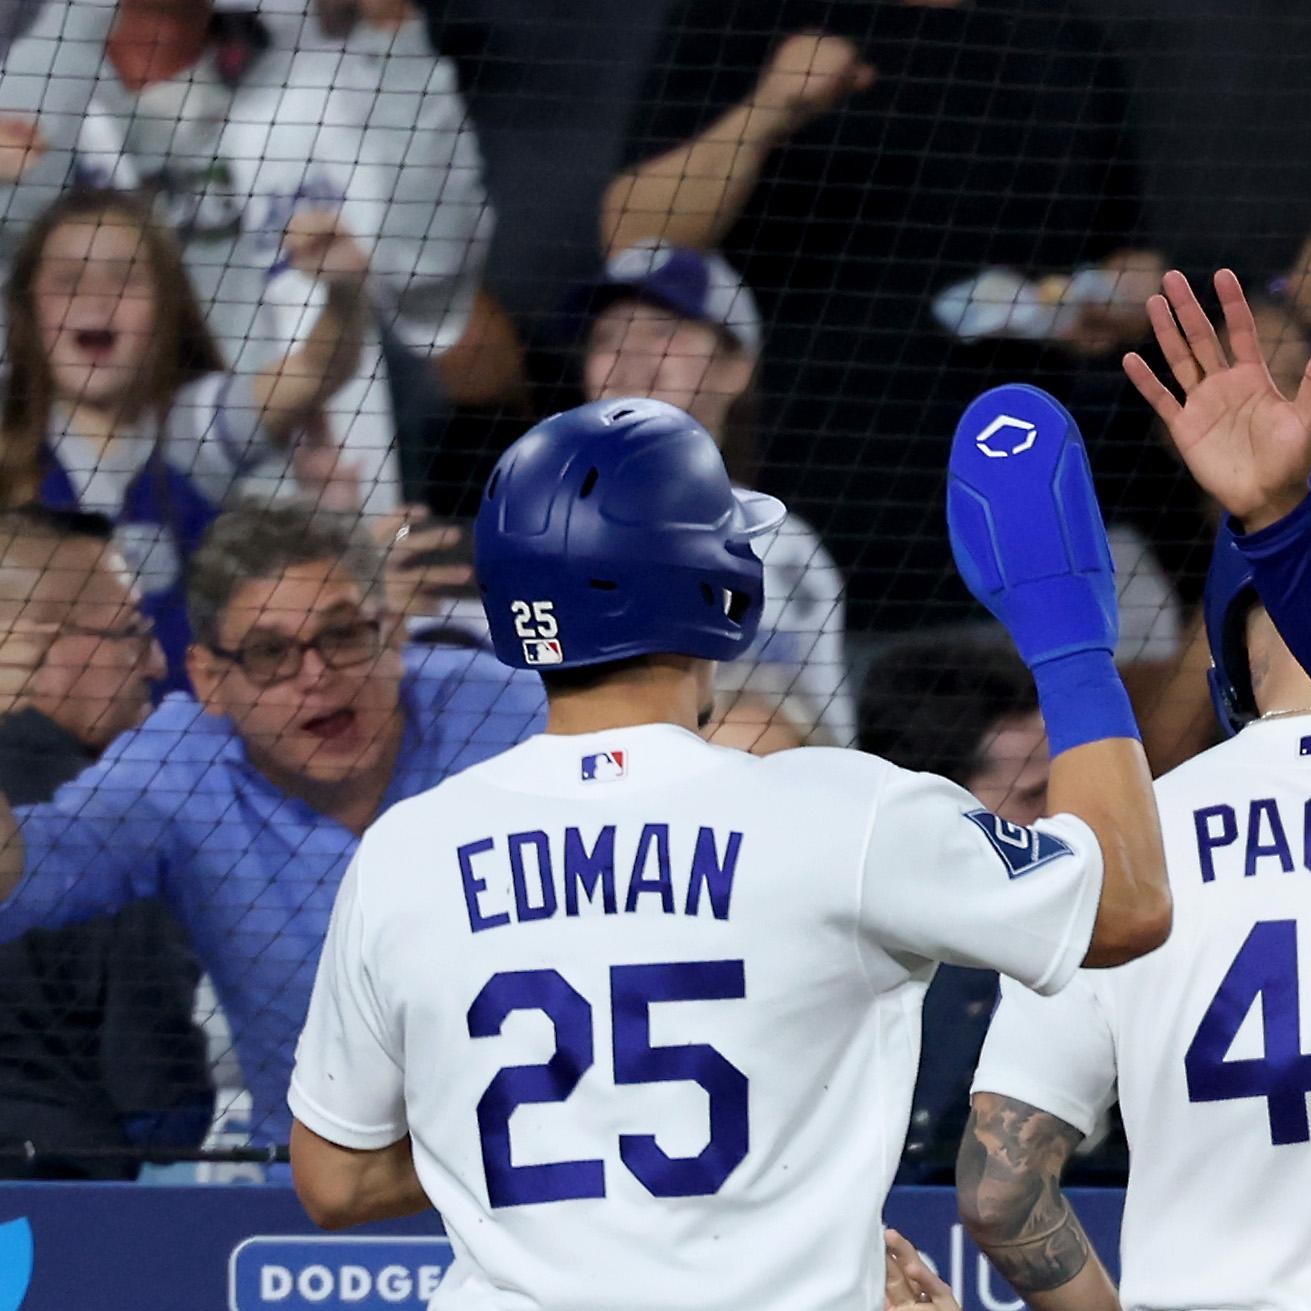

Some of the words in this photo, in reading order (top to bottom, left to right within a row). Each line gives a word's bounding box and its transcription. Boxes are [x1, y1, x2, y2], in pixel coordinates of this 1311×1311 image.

[511, 600, 559, 638] 25
[457, 823, 744, 933] EDMAN
[466, 958, 749, 1209] 25
